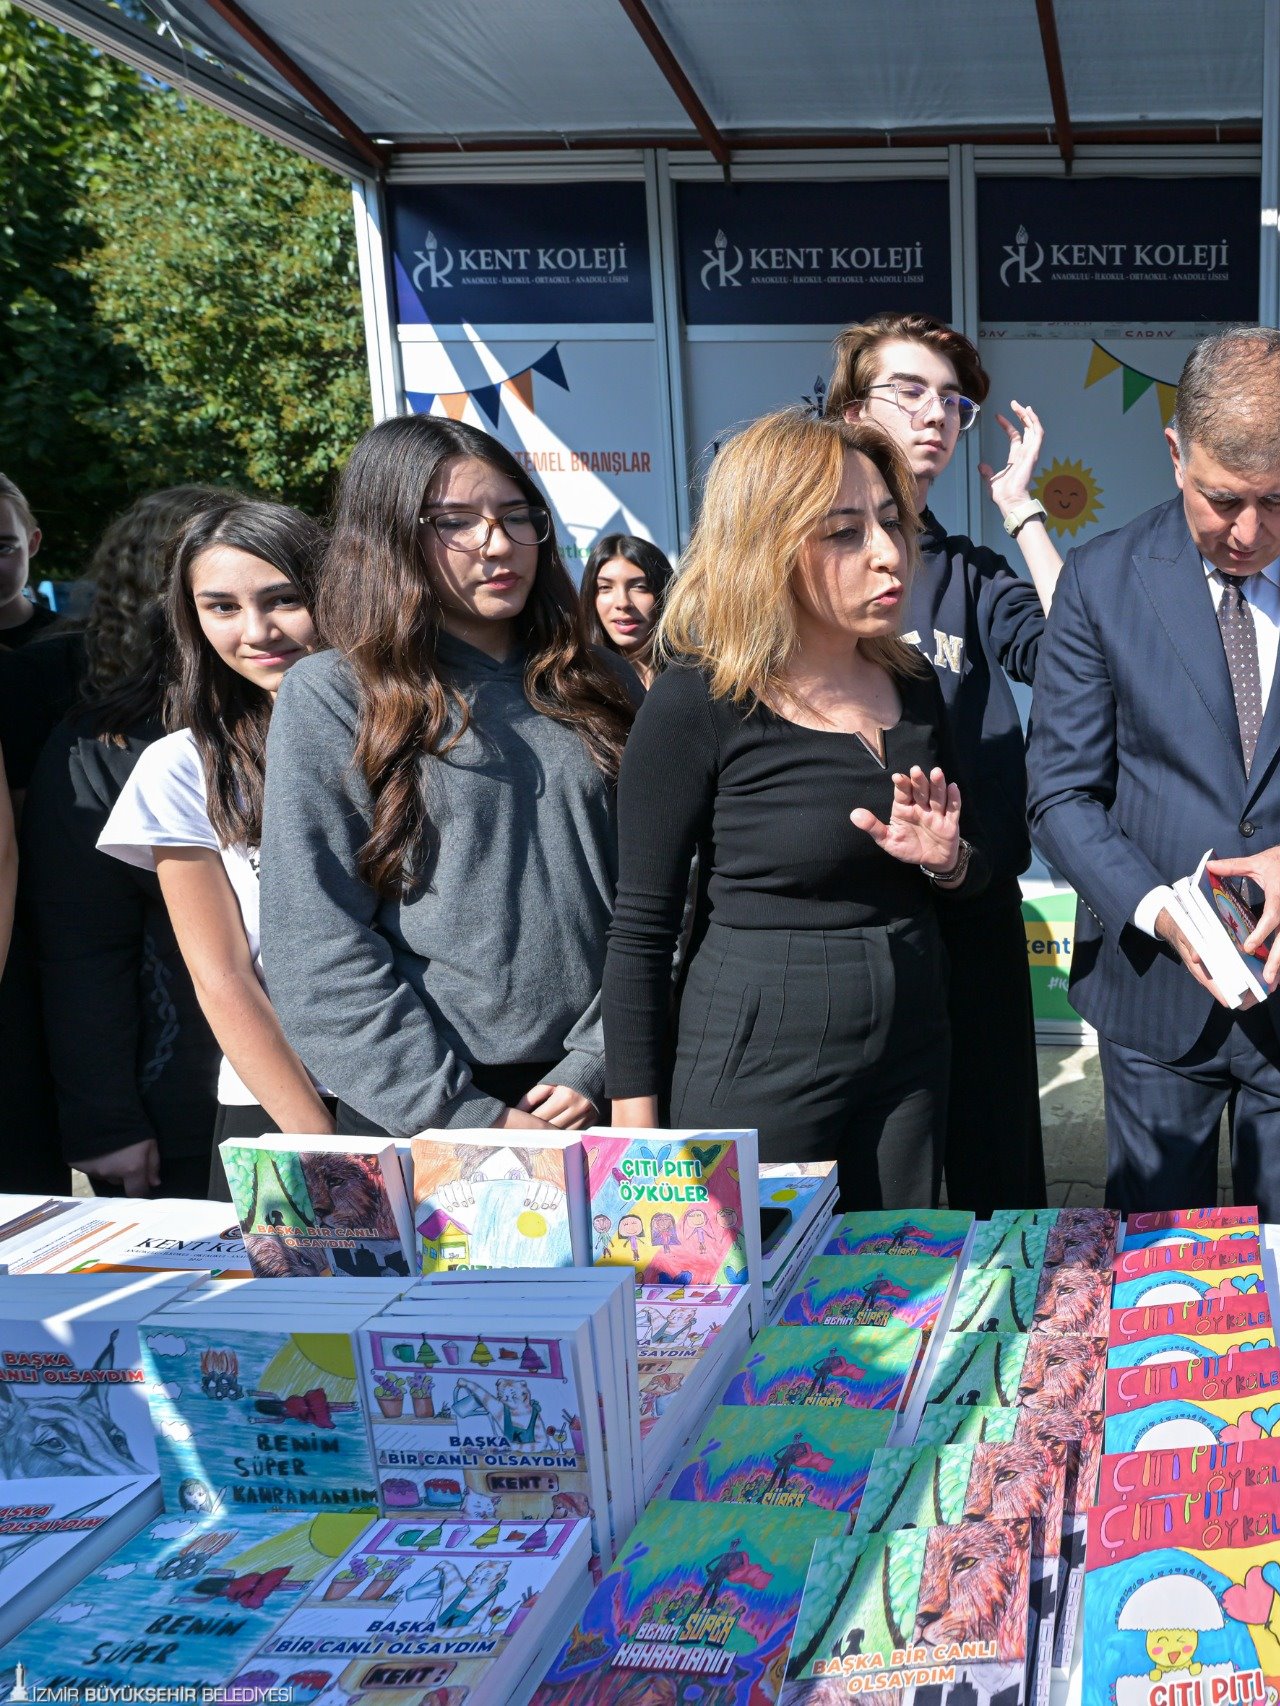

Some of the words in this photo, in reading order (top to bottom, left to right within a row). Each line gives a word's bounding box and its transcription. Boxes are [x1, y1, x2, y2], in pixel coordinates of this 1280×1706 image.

[459, 249, 530, 270] KENT
[538, 243, 627, 274] KOLEJİ
[750, 248, 823, 268] KENT
[830, 242, 923, 273] KOLEJİ
[1051, 245, 1126, 266] KENT
[1134, 239, 1229, 271] KOLEJİ
[515, 452, 565, 471] TEMEL
[571, 452, 651, 475] BRANŞLAR
[620, 1159, 661, 1180] ÇITI
[663, 1159, 702, 1179] PITI
[618, 1183, 709, 1203] ÖYKÜLER
[257, 1223, 305, 1238] BAŞKA
[307, 1223, 332, 1237] BİR
[334, 1227, 380, 1238] CANLI
[134, 1237, 210, 1250] KENT
[284, 1237, 356, 1250] OLSAYDIM
[4, 1352, 72, 1369] BAŞKA
[44, 1370, 145, 1384] OLSAYDIM
[257, 1433, 339, 1453] BENİM
[449, 1435, 512, 1450] BAŞKA
[234, 1456, 308, 1477] SÜPER
[388, 1450, 419, 1465] BİR
[425, 1453, 479, 1466] CANLI
[485, 1453, 576, 1468] OLSAYDIM
[490, 1476, 541, 1491] KENT
[1101, 1500, 1173, 1558] ÇITI
[1184, 1487, 1241, 1523] PITI
[145, 1611, 246, 1637] BENİM
[365, 1619, 437, 1635] BAŞKA
[678, 1608, 736, 1645] SÜPER
[81, 1640, 181, 1665] SÜPER
[274, 1637, 314, 1654] BİR
[318, 1639, 384, 1654] CANLI
[387, 1639, 497, 1656] OLSAYDIM
[611, 1642, 738, 1674] KAHRAMANIM
[812, 1652, 885, 1679] BAŞKA
[889, 1642, 926, 1665] BİR
[932, 1640, 997, 1662] CANLI
[369, 1667, 435, 1684] KENT
[847, 1667, 956, 1695] OLSAYDIM
